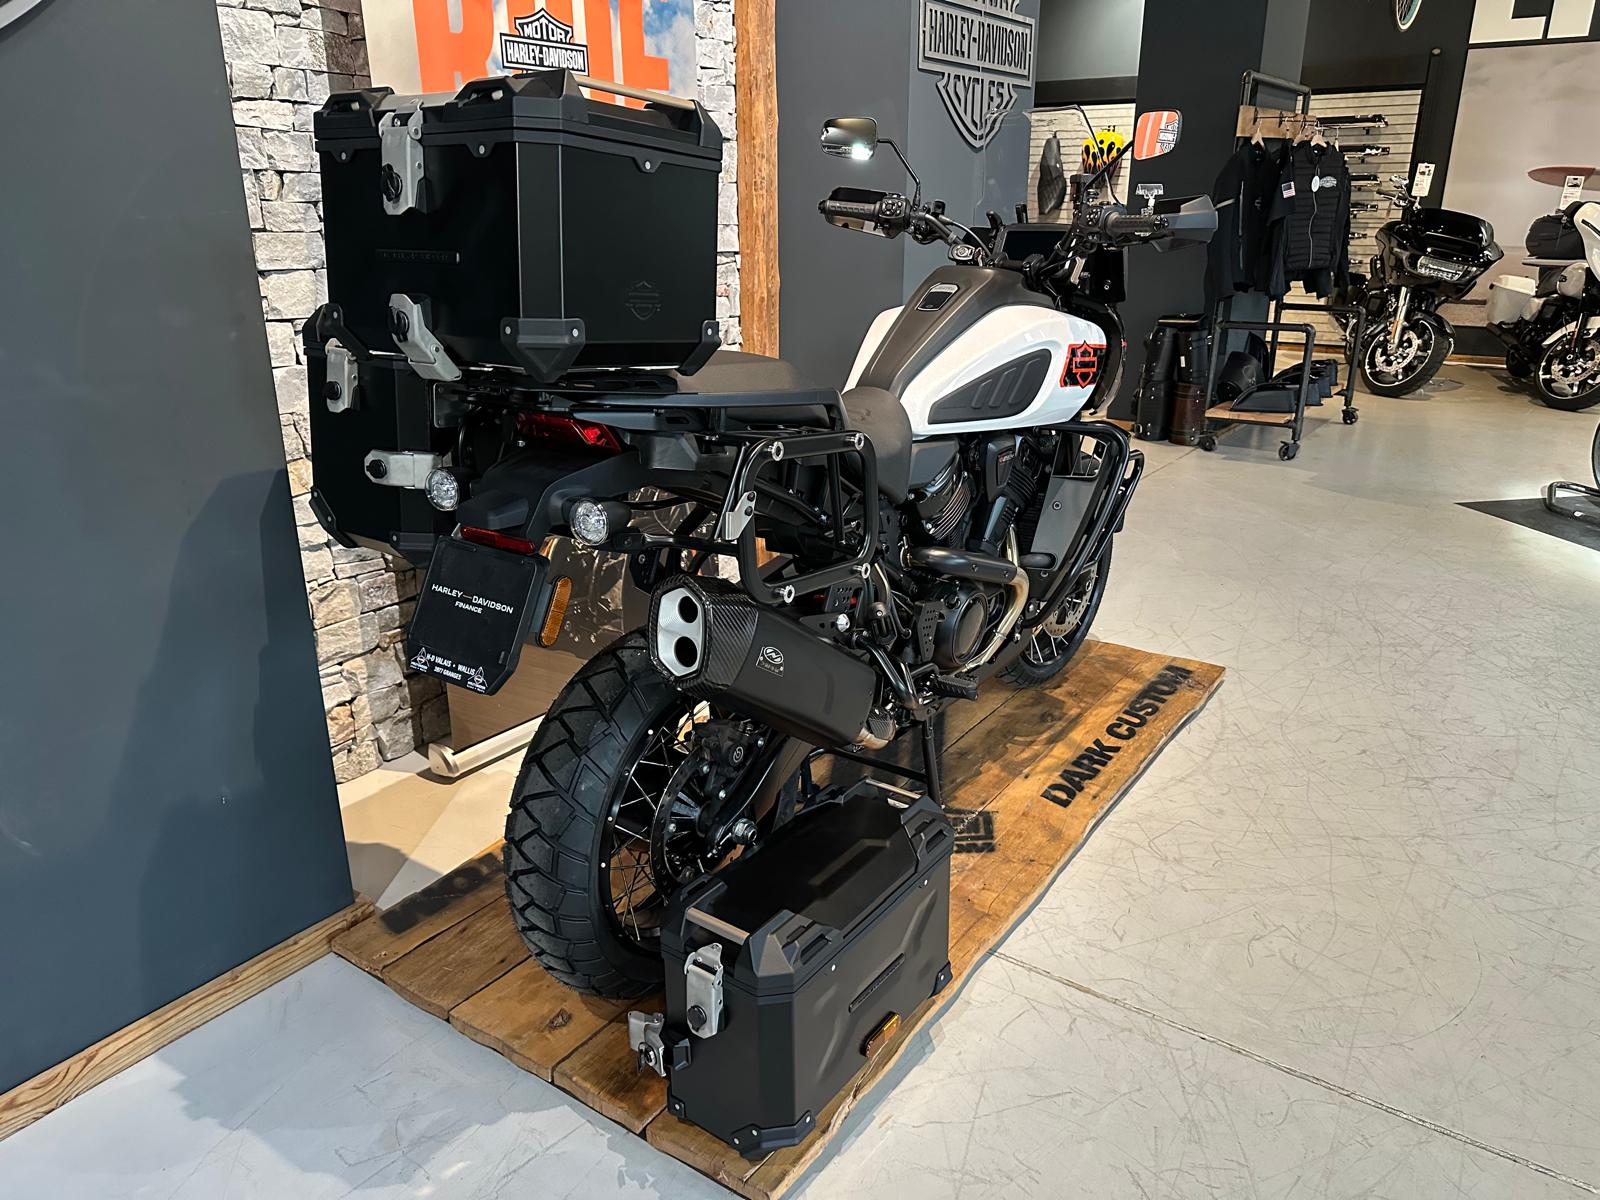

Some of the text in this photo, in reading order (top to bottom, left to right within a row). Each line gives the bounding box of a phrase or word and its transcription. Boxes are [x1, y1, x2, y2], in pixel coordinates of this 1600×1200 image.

[523, 16, 566, 43] MOTOR
[929, 8, 1028, 70] HARLEY-DAVIDSON
[506, 41, 584, 70] HARLEY-DAVIDSON
[952, 74, 1005, 131] CYCLES
[454, 600, 483, 614] FINANCE
[1040, 664, 1194, 809] DARK CUSTOM
